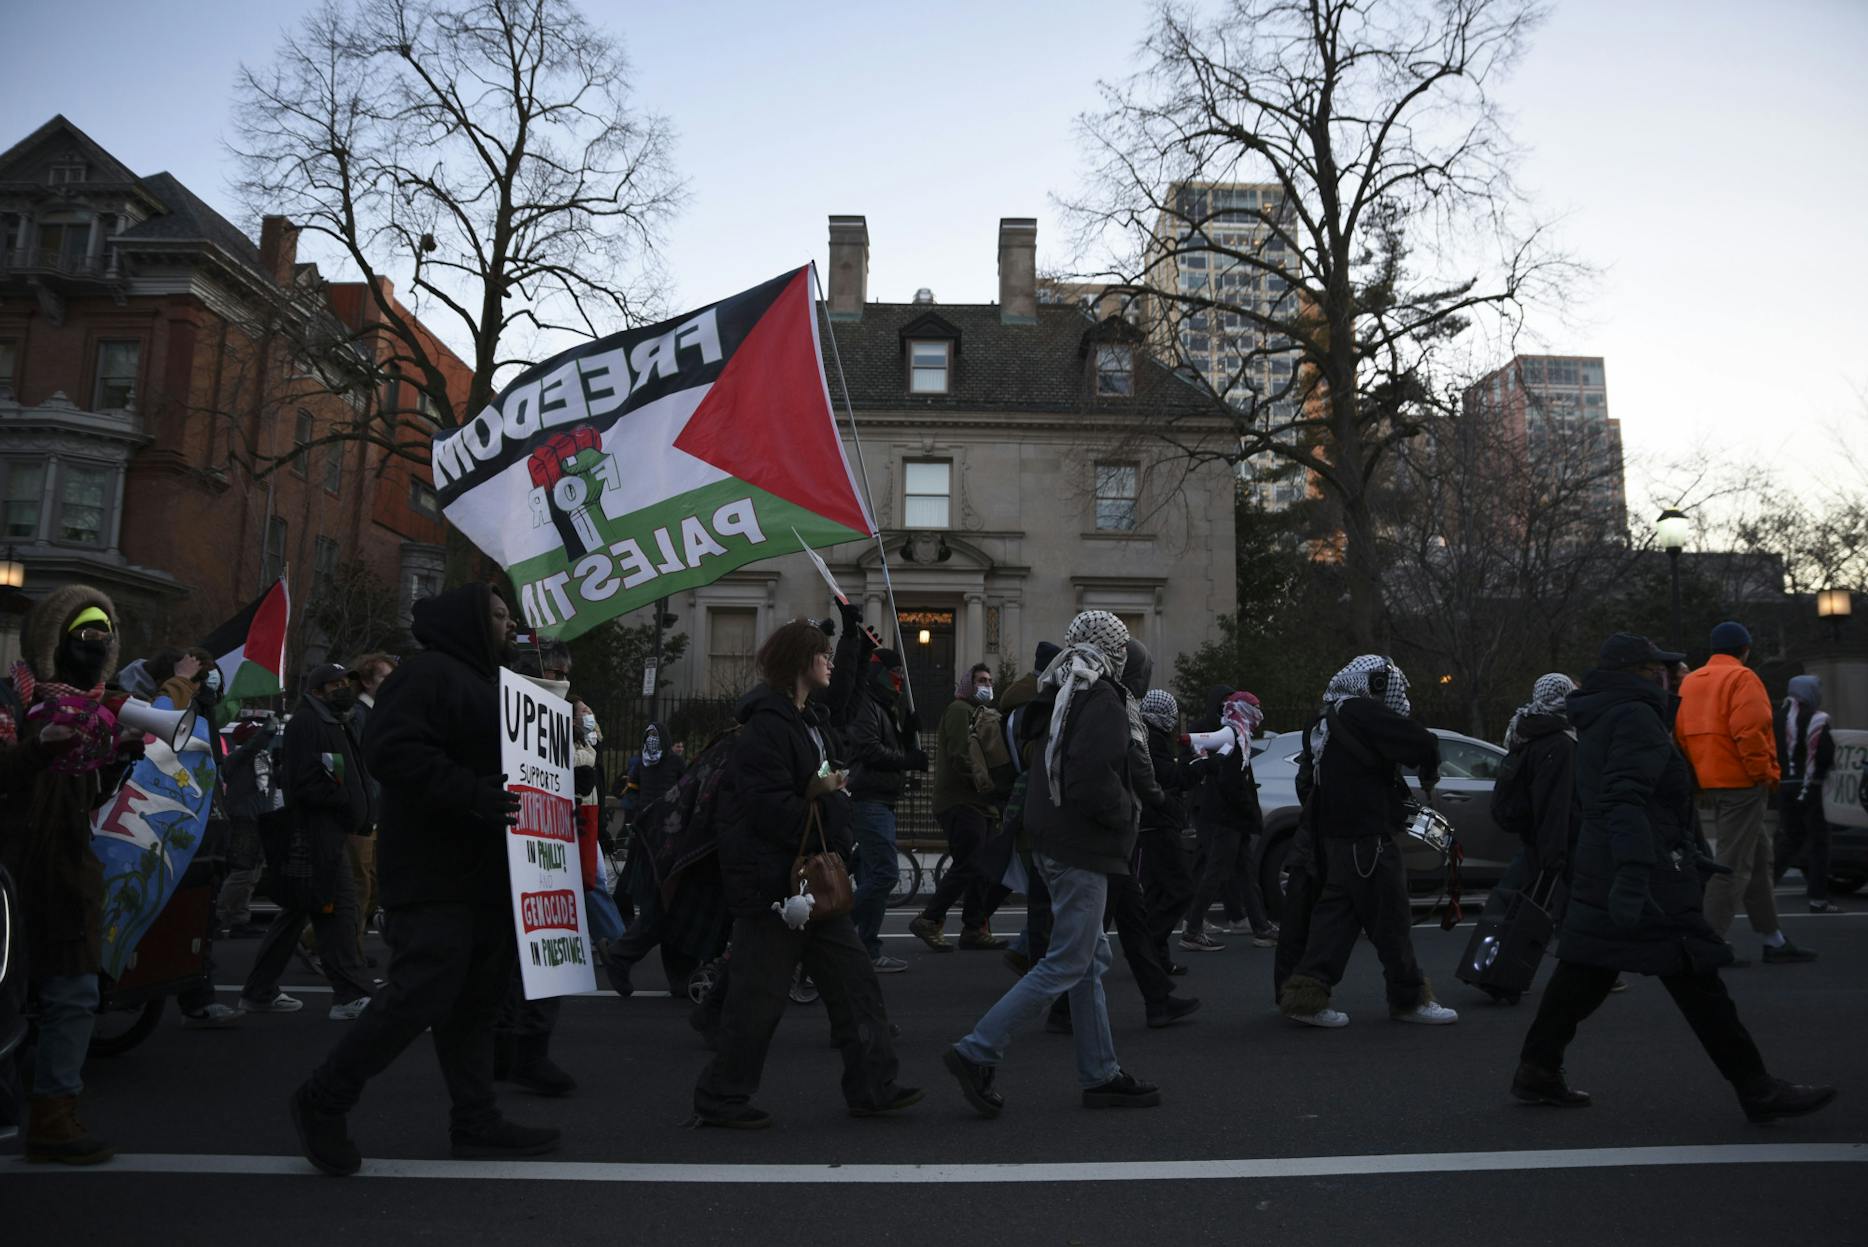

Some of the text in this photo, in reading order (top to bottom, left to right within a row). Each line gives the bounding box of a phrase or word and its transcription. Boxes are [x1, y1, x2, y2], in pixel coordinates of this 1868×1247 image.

[505, 685, 570, 770] UPENN
[520, 763, 560, 792] SUPPORTS
[527, 840, 567, 873] IN PHILLY!
[523, 895, 576, 927] GENOCIDE
[531, 936, 586, 967] IN PALESTINE!
